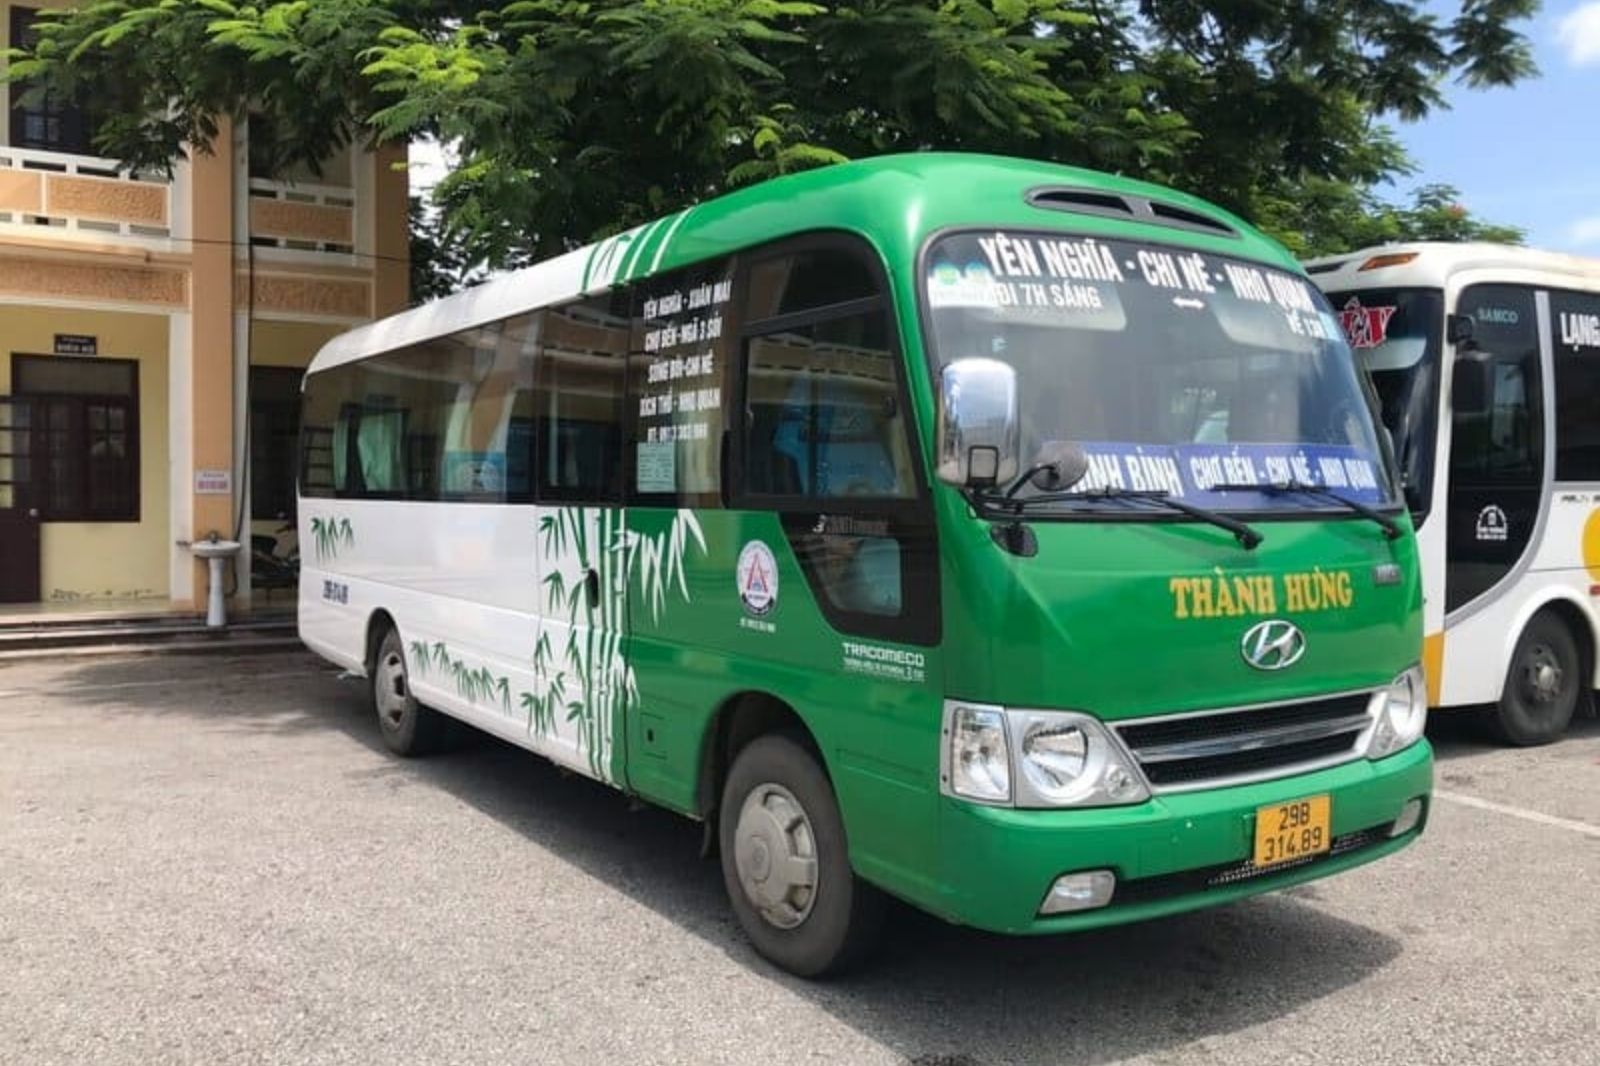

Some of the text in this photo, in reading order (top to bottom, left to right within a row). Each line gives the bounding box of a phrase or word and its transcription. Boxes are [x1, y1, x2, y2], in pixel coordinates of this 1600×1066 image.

[978, 231, 1041, 277] YÊN
[1037, 238, 1124, 282] NGHĨA
[1137, 249, 1182, 290] CHI
[1020, 283, 1049, 307] 7H
[1049, 279, 1103, 309] SÁNG
[1125, 446, 1185, 498] BÌNH
[1169, 565, 1277, 618] THÀNH
[1264, 826, 1323, 861] 314.89
